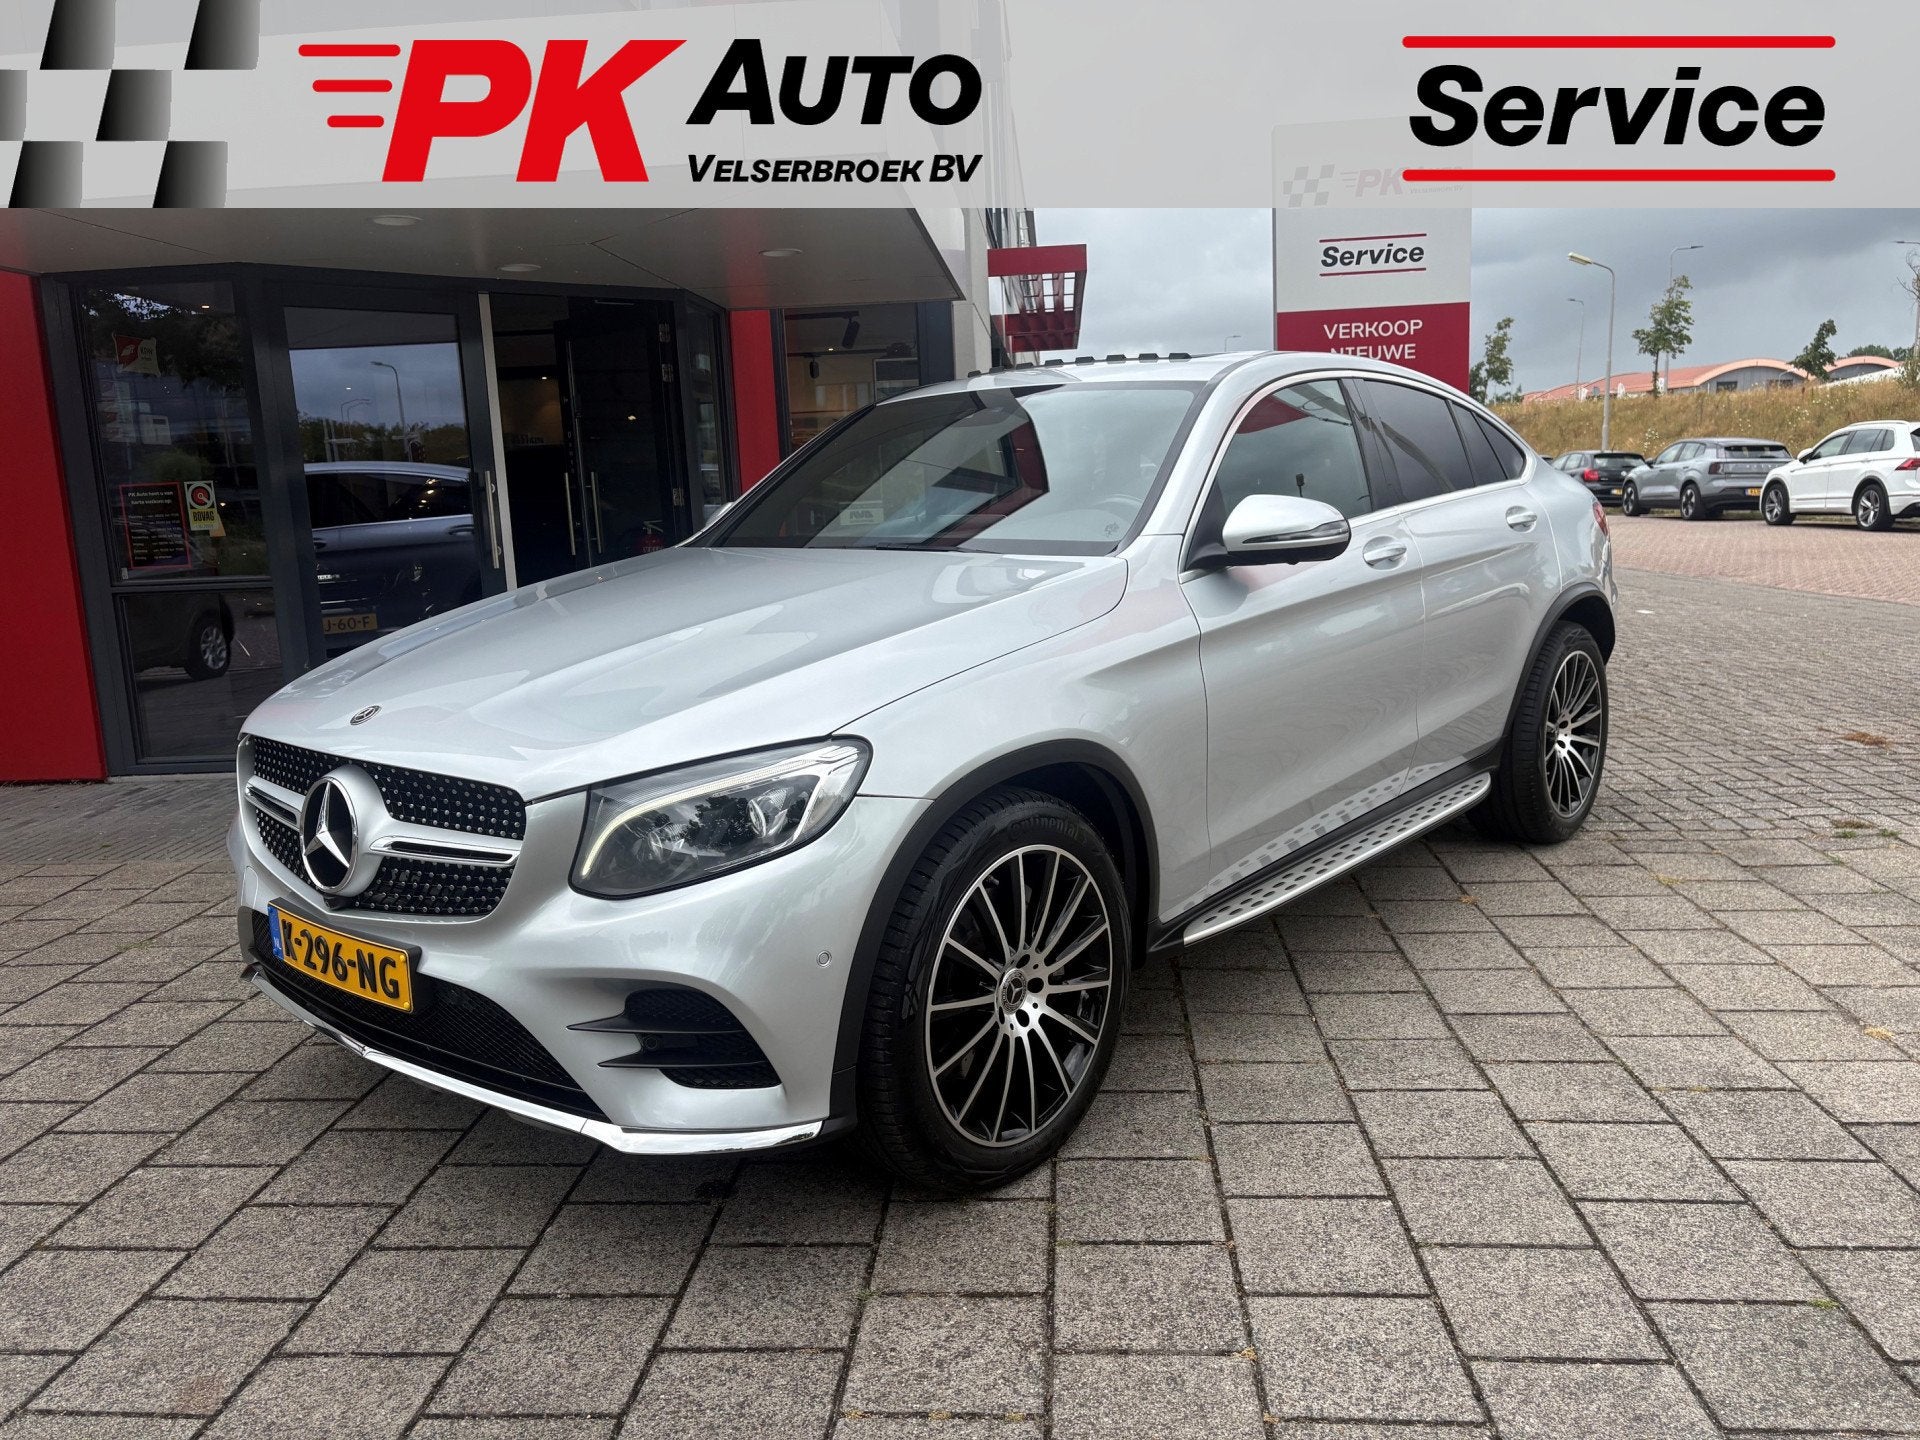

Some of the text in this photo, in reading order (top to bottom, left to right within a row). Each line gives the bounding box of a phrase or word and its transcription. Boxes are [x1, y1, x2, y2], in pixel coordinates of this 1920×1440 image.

[1321, 243, 1425, 268] Service
[1323, 319, 1423, 340] VERKOOP
[281, 918, 400, 1000] K-296-NG
